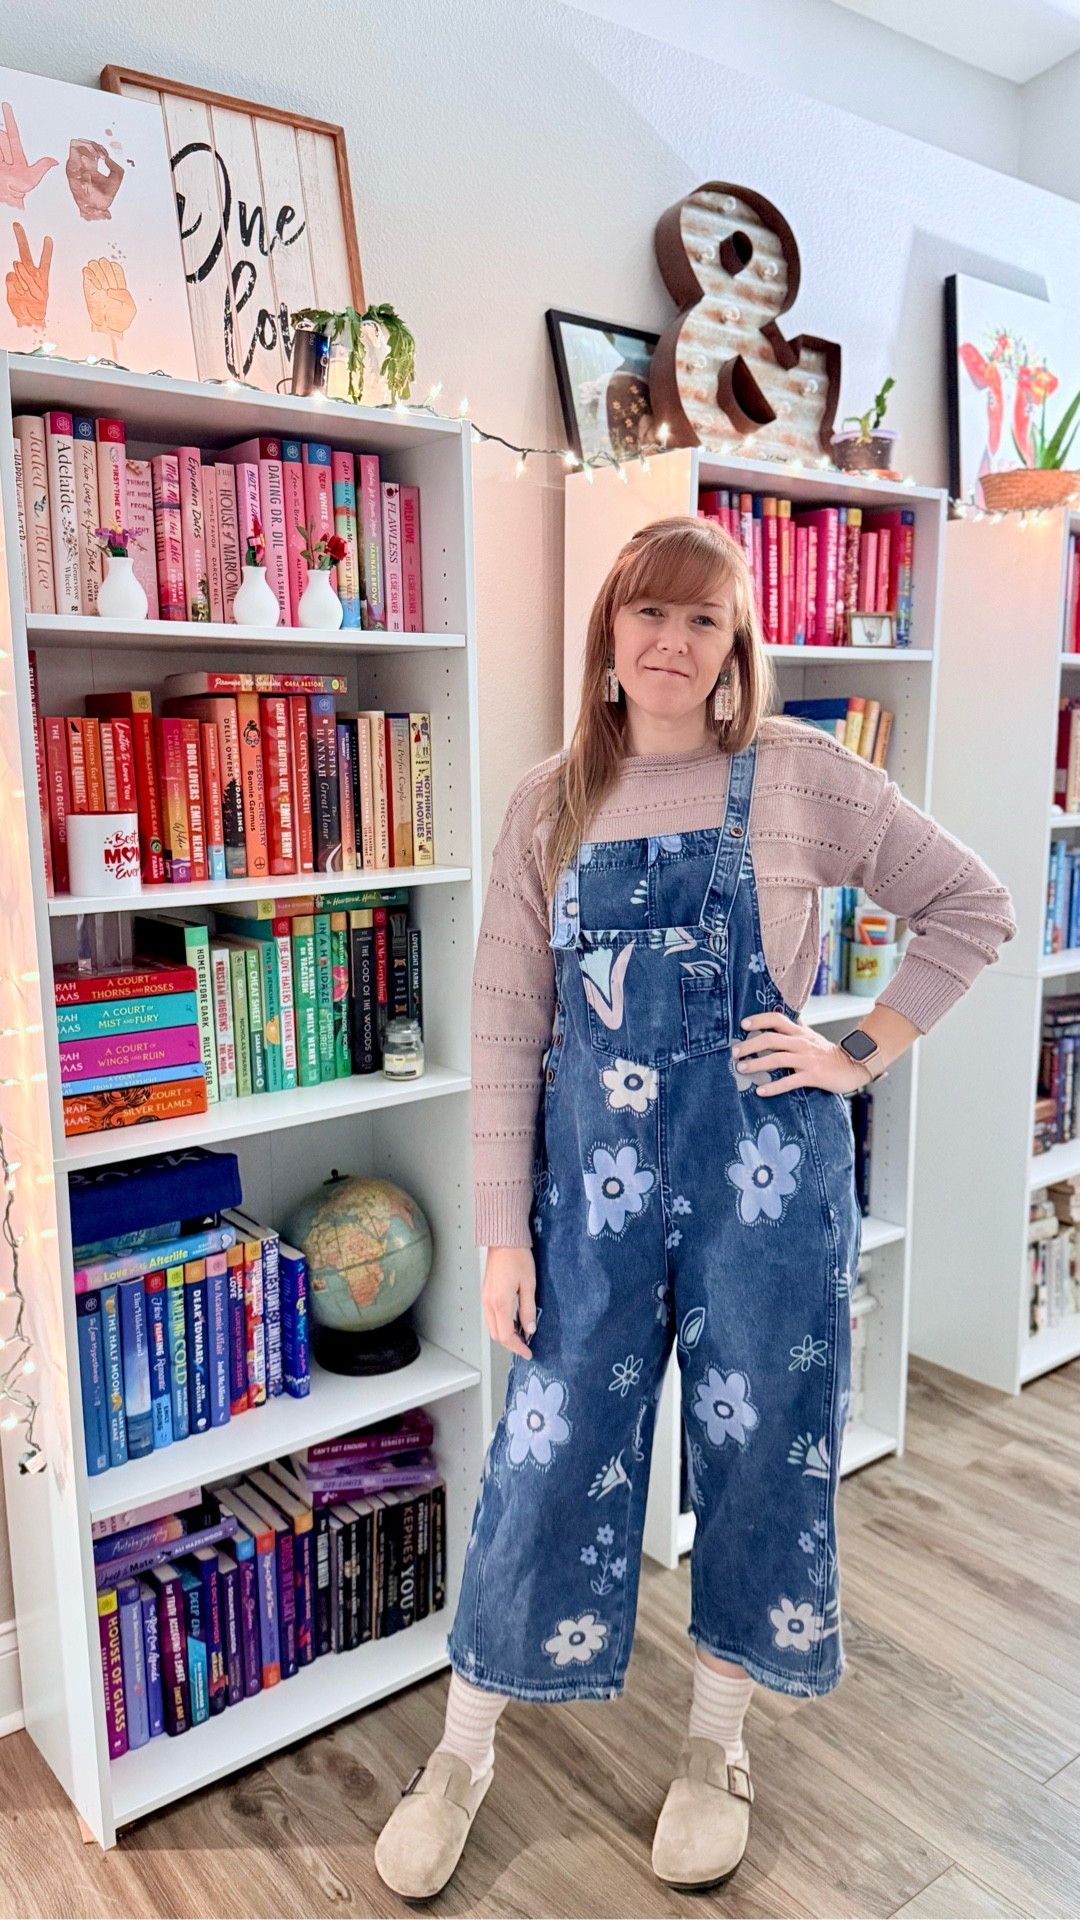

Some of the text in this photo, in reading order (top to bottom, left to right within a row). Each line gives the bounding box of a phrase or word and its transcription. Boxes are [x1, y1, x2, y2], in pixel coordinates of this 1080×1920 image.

[171, 142, 306, 284] One
[30, 431, 46, 490] Jaded
[57, 440, 75, 514] Adelaide
[319, 471, 327, 489] RED
[82, 445, 97, 572] The Two Lives of Lydia Bird
[188, 457, 202, 538] Expiration Dates
[268, 465, 284, 549] DATING DR. DIL
[319, 492, 328, 520] WHITE
[404, 499, 415, 544] WILD LOVE
[35, 524, 51, 589] Ela Lee
[387, 501, 398, 564] FLAWLESS
[369, 543, 377, 575] HANNAH
[278, 581, 286, 611] SHARMA
[769, 588, 778, 628] PROJECT
[71, 732, 86, 804] THE DEAD ROMANTICS
[186, 743, 199, 800] BOOK LOVERS
[276, 703, 289, 793] GREAT BIG BEAUTIFUL LIFE
[297, 706, 311, 814] The Correspondent
[316, 729, 326, 777] HANNAH
[328, 729, 336, 777] KRISTIN
[54, 770, 63, 793] LOVE
[247, 771, 256, 798] Bonnie
[56, 796, 67, 843] DECEPTION
[190, 805, 204, 863] EMILY HENRY
[280, 803, 293, 859] EMILY HENRY
[320, 782, 330, 839] Great Alone
[416, 780, 425, 838] THE MOVIES
[112, 830, 137, 847] Best
[280, 941, 291, 1004] THE LOVE HATERS
[362, 959, 370, 983] GOD
[411, 933, 420, 990] LOVELIGHT FARMS
[197, 949, 209, 1028] HOME BEFORE DARK
[215, 961, 228, 1032] KRISTAN HIGGINS
[248, 954, 260, 1024] The CHEAT SHEET
[363, 986, 371, 996] OF
[363, 999, 371, 1011] THE
[282, 1010, 294, 1068] KATHERINE CENTER
[306, 1008, 314, 1034] EMILY
[364, 1013, 372, 1051] WOODS
[202, 1037, 213, 1085] RILEY SAGER
[123, 1100, 192, 1118] SILVER FLAMES
[104, 1249, 188, 1282] Love Afterlife
[229, 1276, 238, 1299] LOVE
[254, 1259, 263, 1315] HELLO STRANGER
[266, 1250, 280, 1312] FUNNY STORY
[135, 1309, 144, 1357] Hilderbrand
[172, 1300, 184, 1337] KILLING
[193, 1289, 204, 1363] DEAR EDWARD
[215, 1280, 224, 1355] An Academic Affair
[107, 1312, 120, 1395] THE HALF MOON
[152, 1298, 166, 1391] How FREAKING Romantic
[174, 1339, 187, 1384] COLD
[268, 1323, 281, 1380] EMILY HENRY
[216, 1360, 226, 1407] Jodi McAlister
[313, 1442, 368, 1455] CAN'T GET ENOUGH
[186, 1531, 223, 1550] HAZELWOOD
[281, 1536, 294, 1570] CROSS
[400, 1506, 414, 1610] KEPNES YOU
[283, 1572, 295, 1587] MY
[284, 1590, 295, 1621] HEART
[190, 1591, 201, 1637] DEEP END
[108, 1616, 126, 1732] HOUSE OF GLASS
